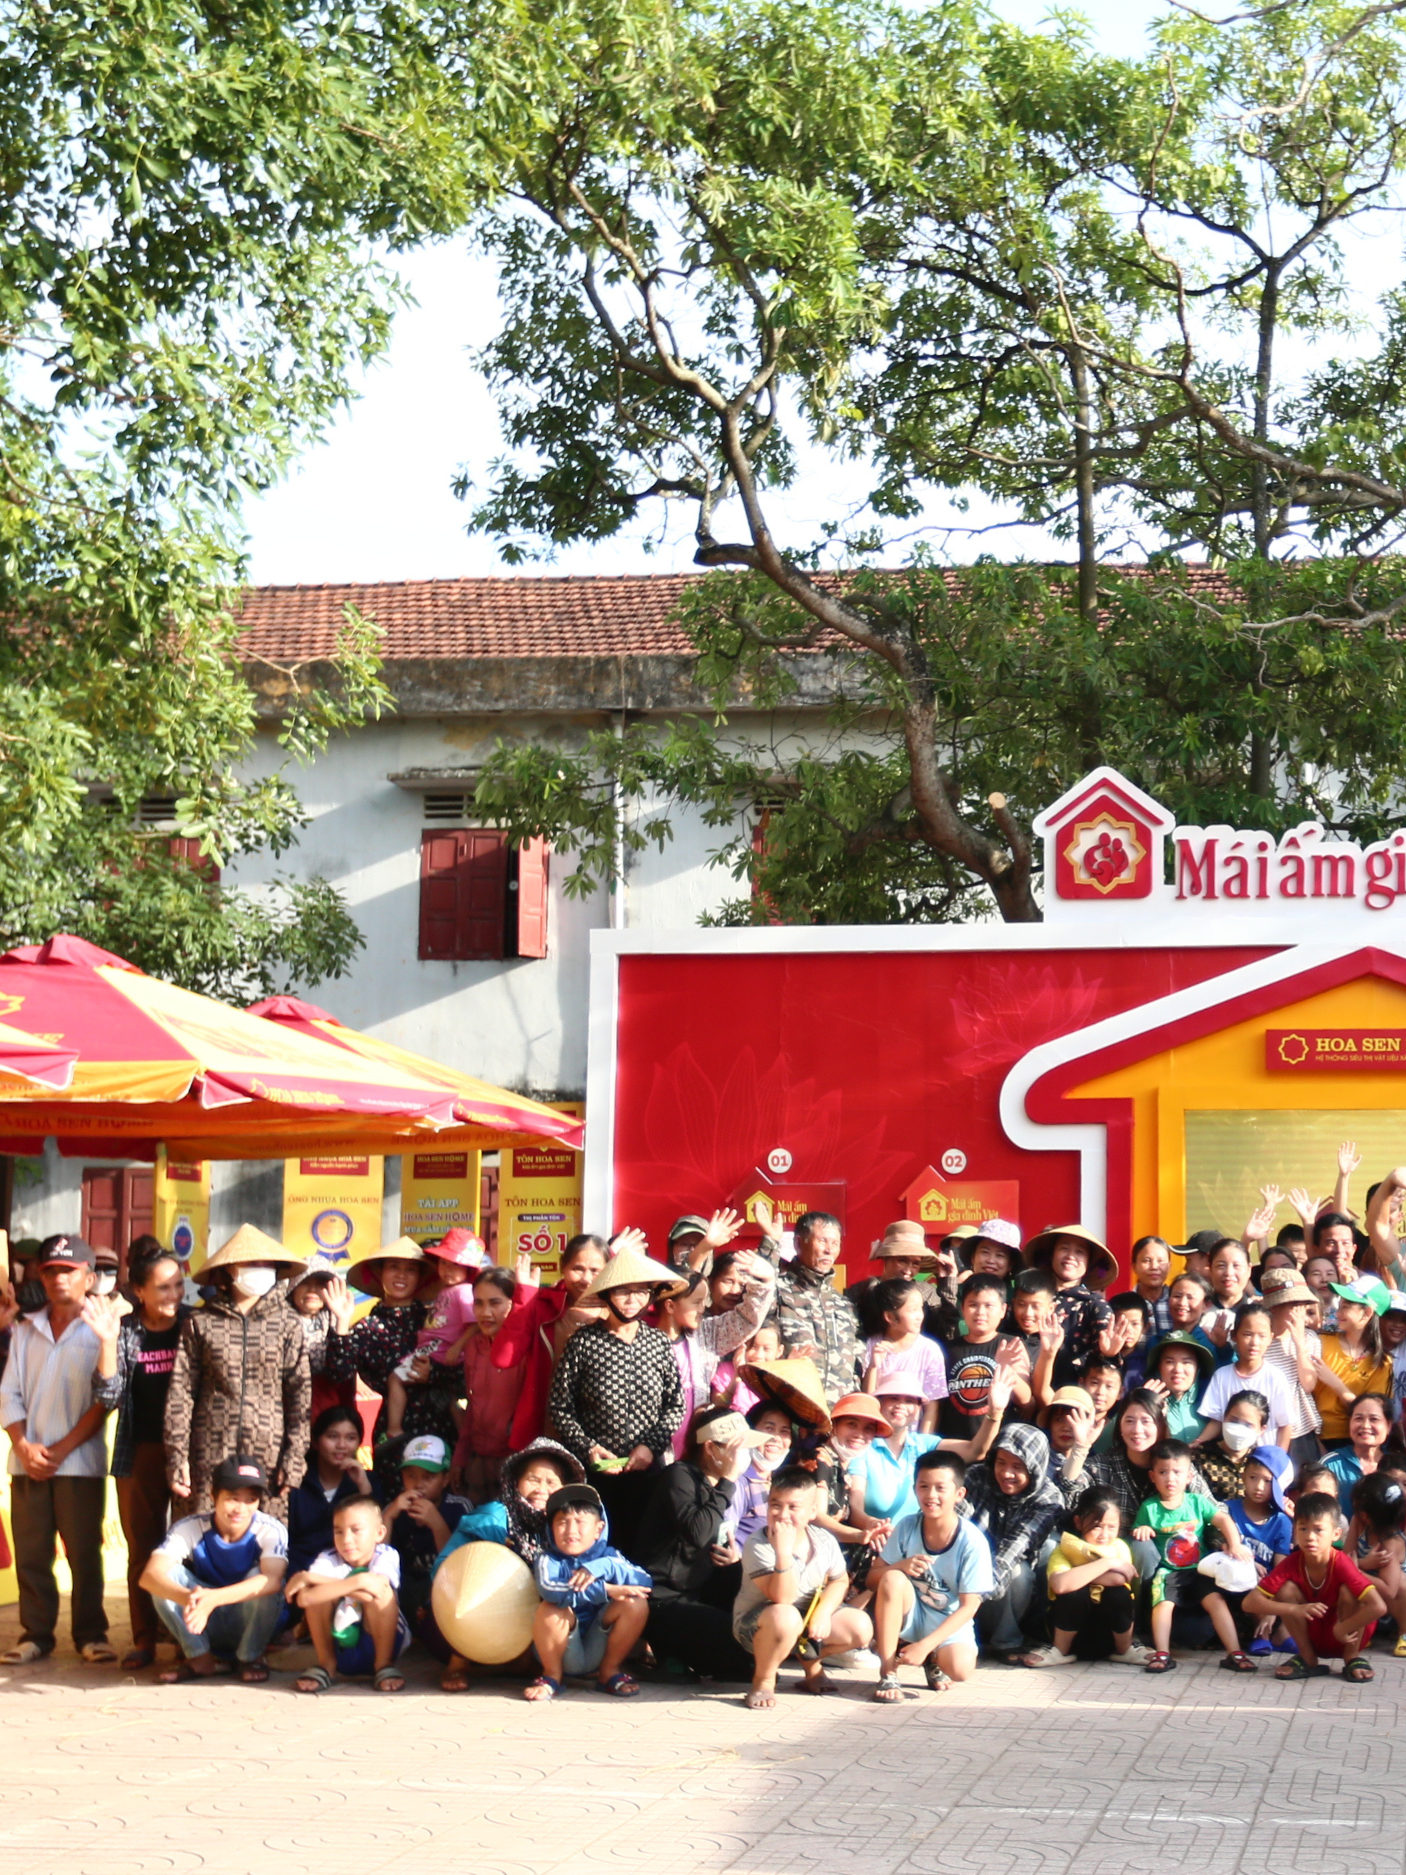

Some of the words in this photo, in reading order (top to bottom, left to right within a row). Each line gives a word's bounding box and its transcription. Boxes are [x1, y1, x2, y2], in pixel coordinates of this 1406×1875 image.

[1316, 1038, 1358, 1052] HOA
[1362, 1038, 1401, 1052] SEN
[516, 1153, 533, 1163] TÔN
[536, 1155, 553, 1163] HOA
[555, 1155, 572, 1163] SEN
[770, 1154, 789, 1167] 01
[945, 1155, 963, 1167] 02
[438, 1198, 459, 1208] APP
[505, 1195, 528, 1207] TÔN
[531, 1198, 555, 1207] HOA
[558, 1197, 581, 1207] SEN
[404, 1212, 424, 1222] HOA
[425, 1212, 443, 1222] SEN
[445, 1211, 475, 1222] HOME
[517, 1223, 553, 1253] SỐ
[556, 1233, 568, 1253] 1
[948, 1378, 992, 1391] PANTHE
